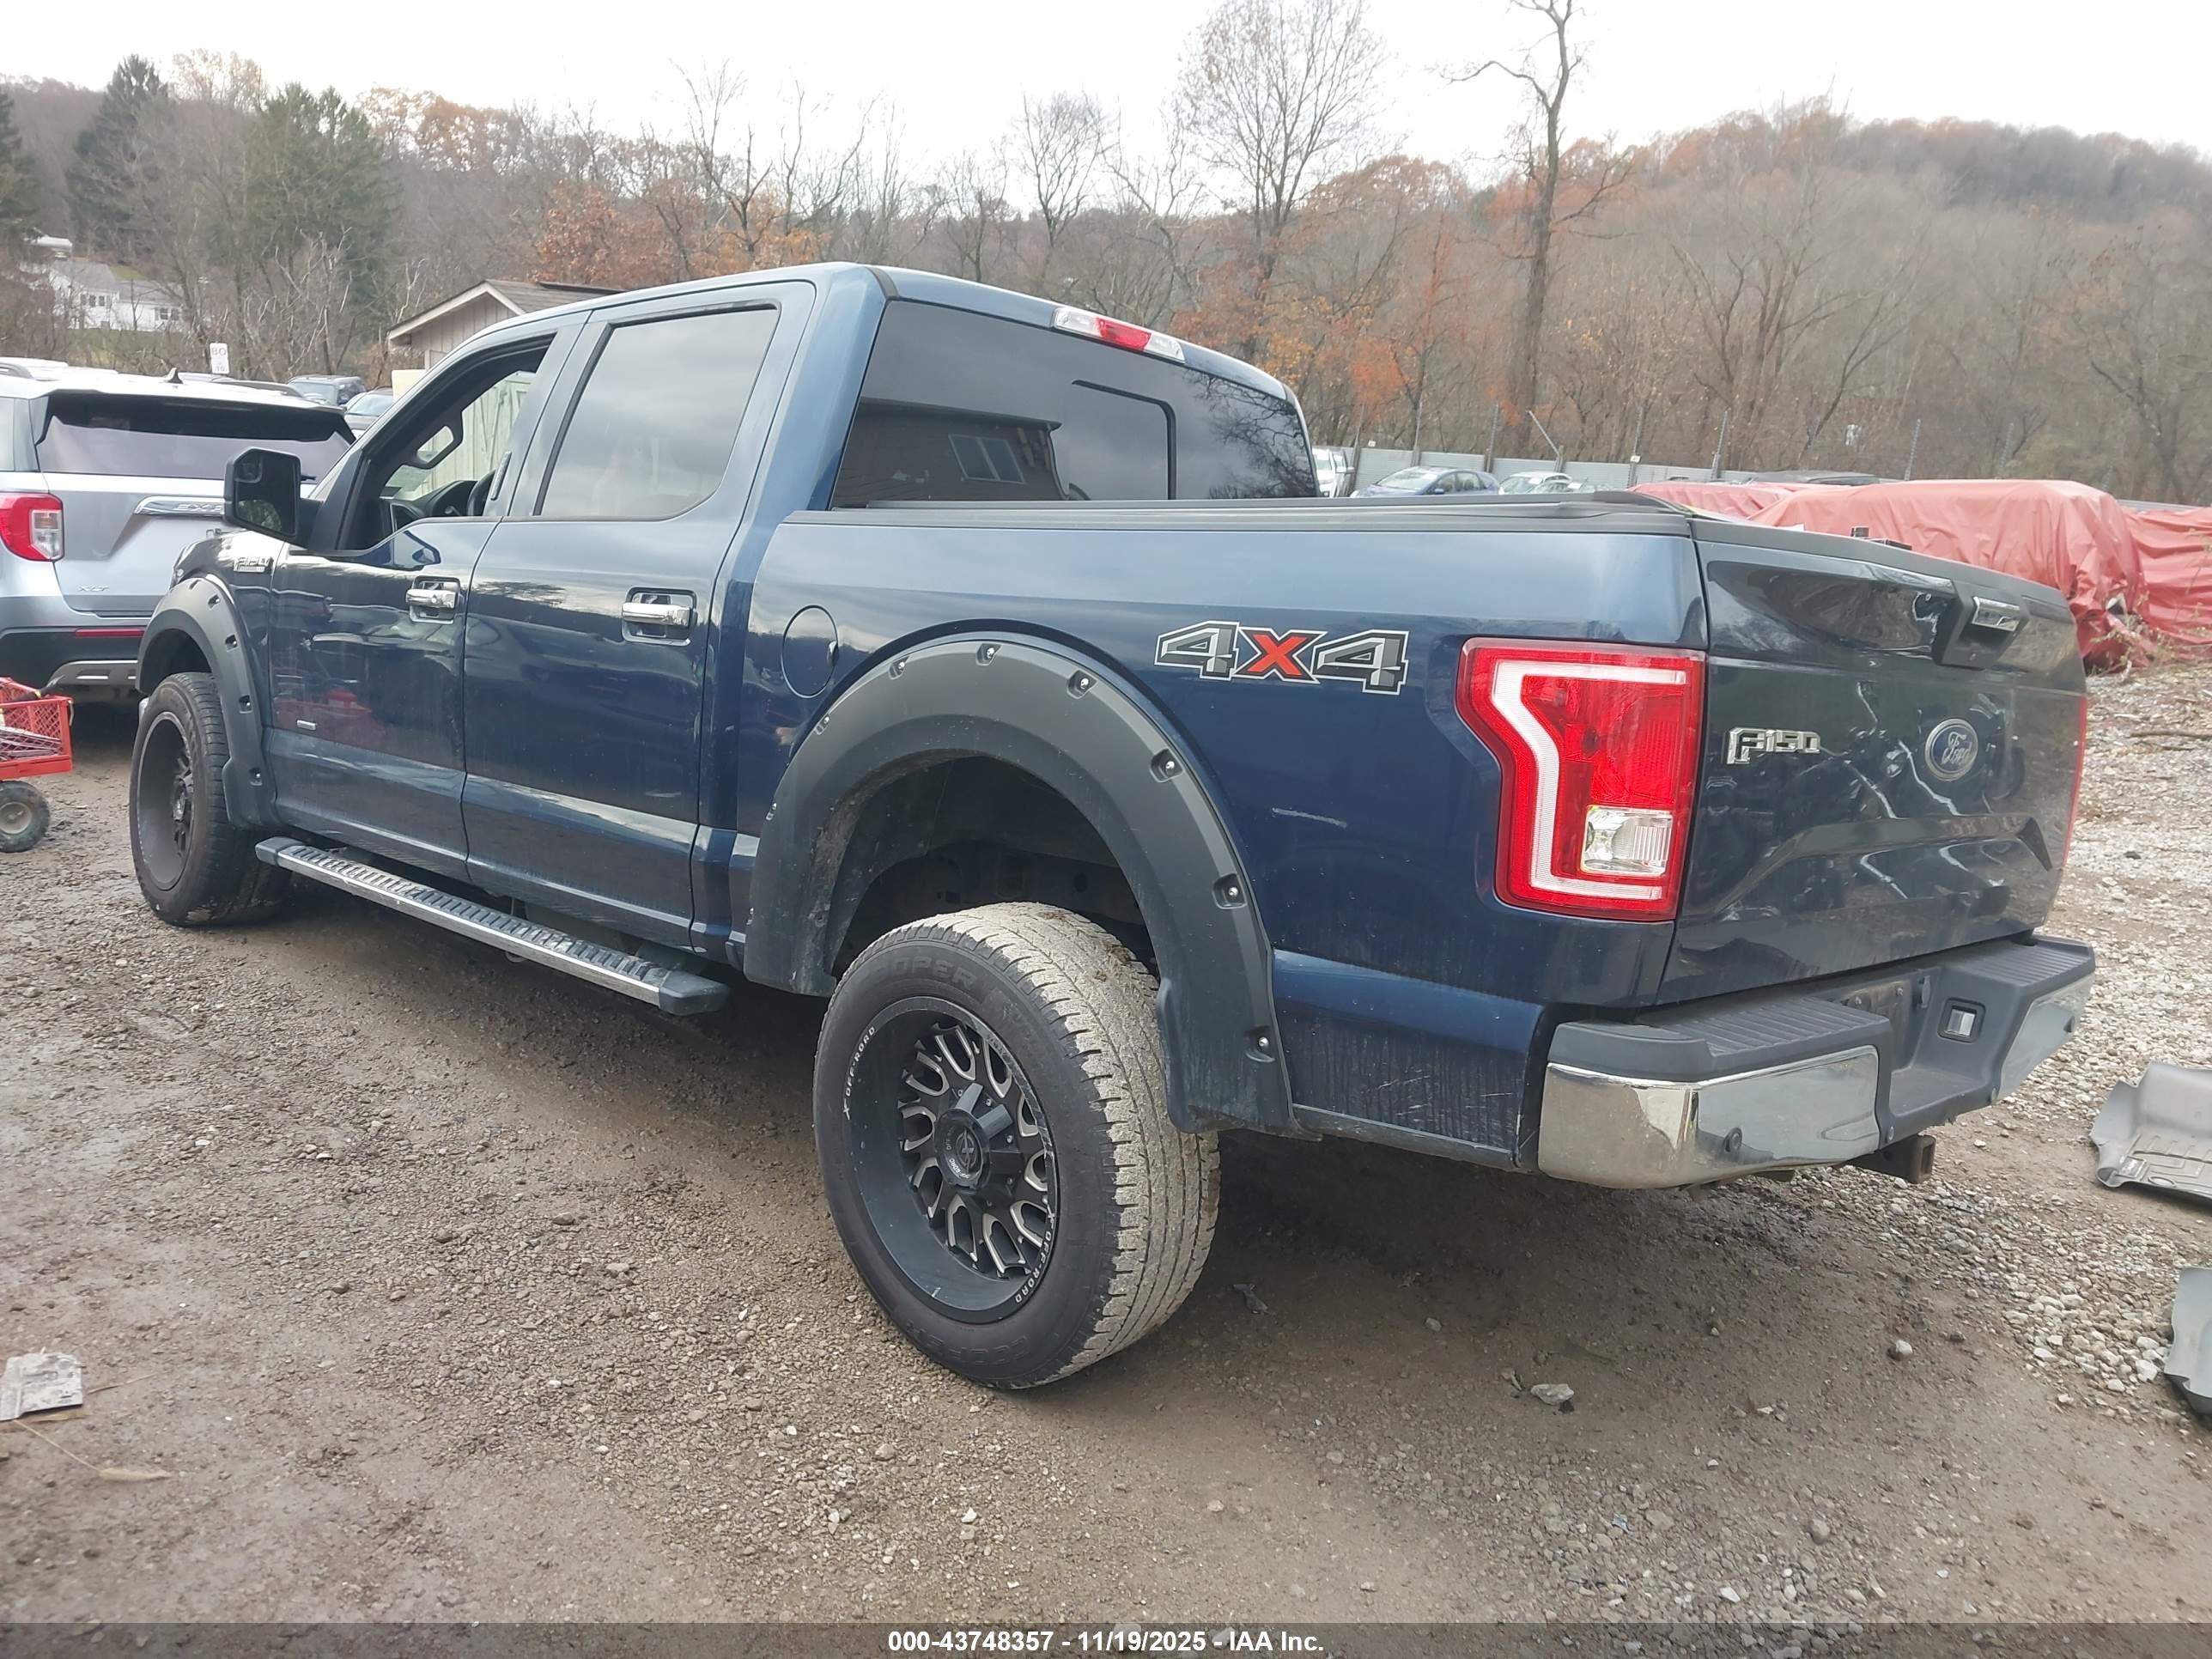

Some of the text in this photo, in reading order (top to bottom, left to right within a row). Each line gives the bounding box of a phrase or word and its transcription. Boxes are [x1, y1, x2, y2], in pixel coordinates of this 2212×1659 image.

[1154, 620, 1409, 696] 4X4
[1941, 731, 1972, 765] Ford
[844, 1026, 876, 1097] OFF-ROAD
[1014, 1231, 1052, 1304] OFF-ROAD
